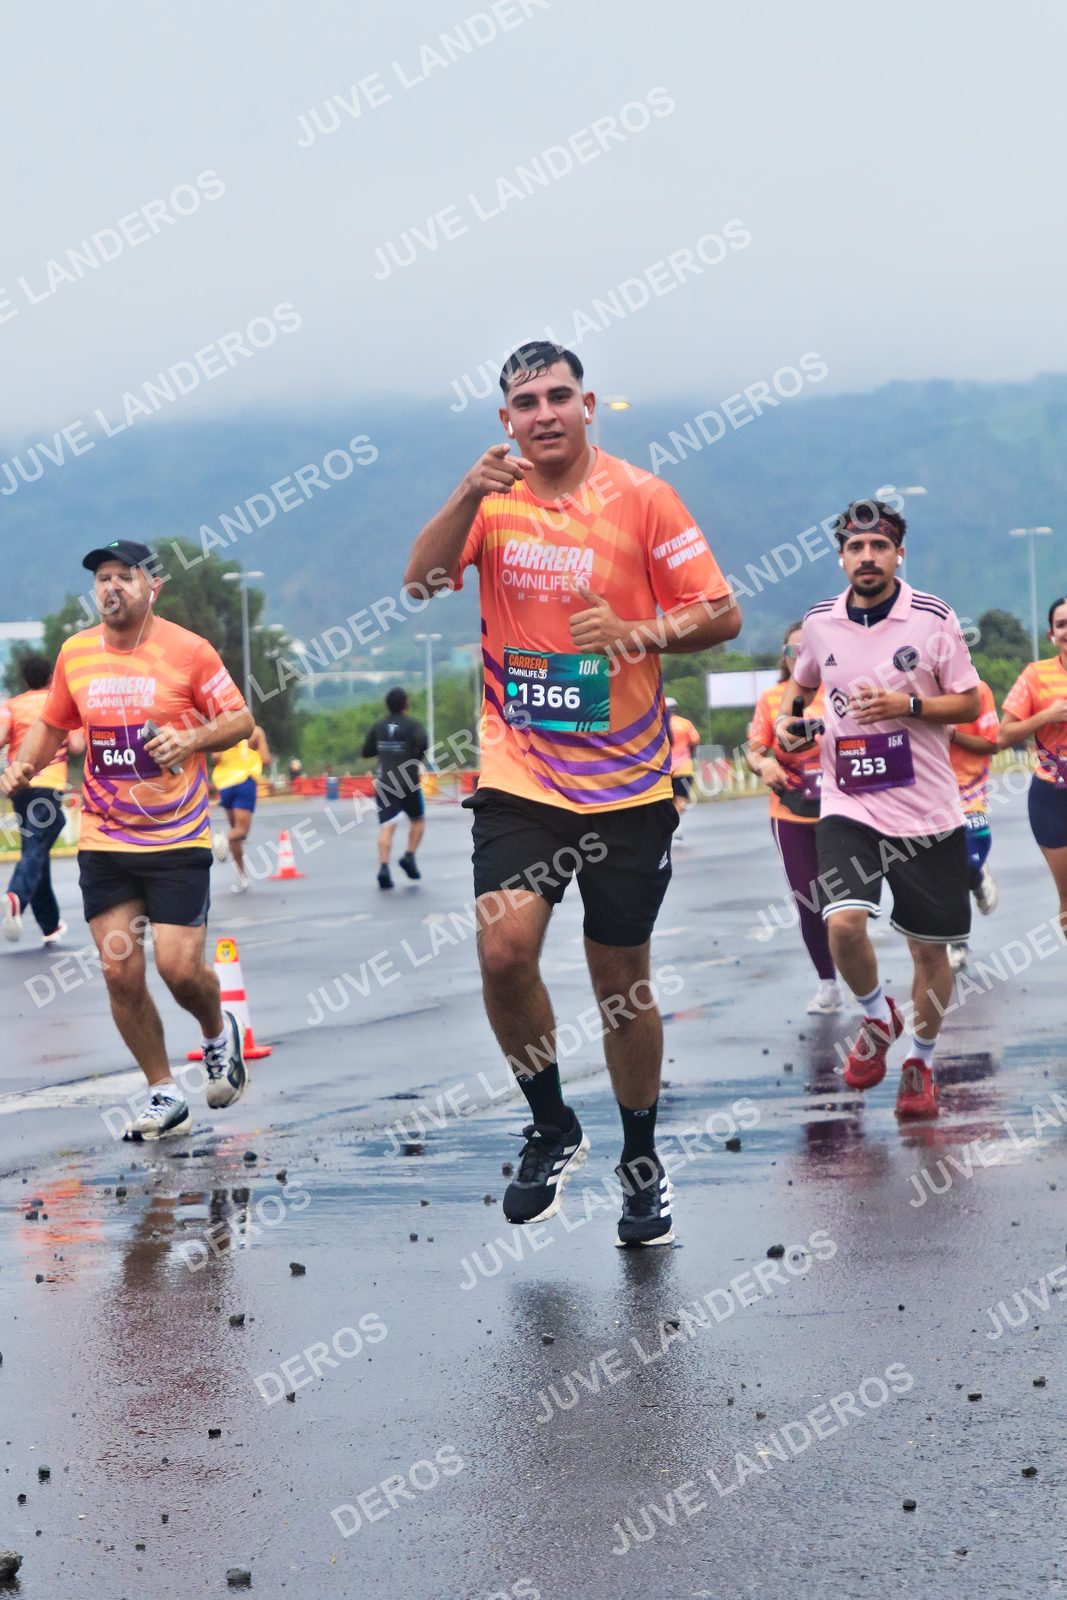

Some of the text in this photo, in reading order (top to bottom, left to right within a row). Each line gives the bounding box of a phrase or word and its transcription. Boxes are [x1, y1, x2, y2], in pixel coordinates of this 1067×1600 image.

[502, 538, 594, 572] CARRERA
[509, 654, 600, 675] CARRERA 10K
[88, 676, 156, 695] CARRERA
[518, 683, 580, 709] 1366
[103, 748, 136, 766] 640
[850, 757, 887, 776] 253
